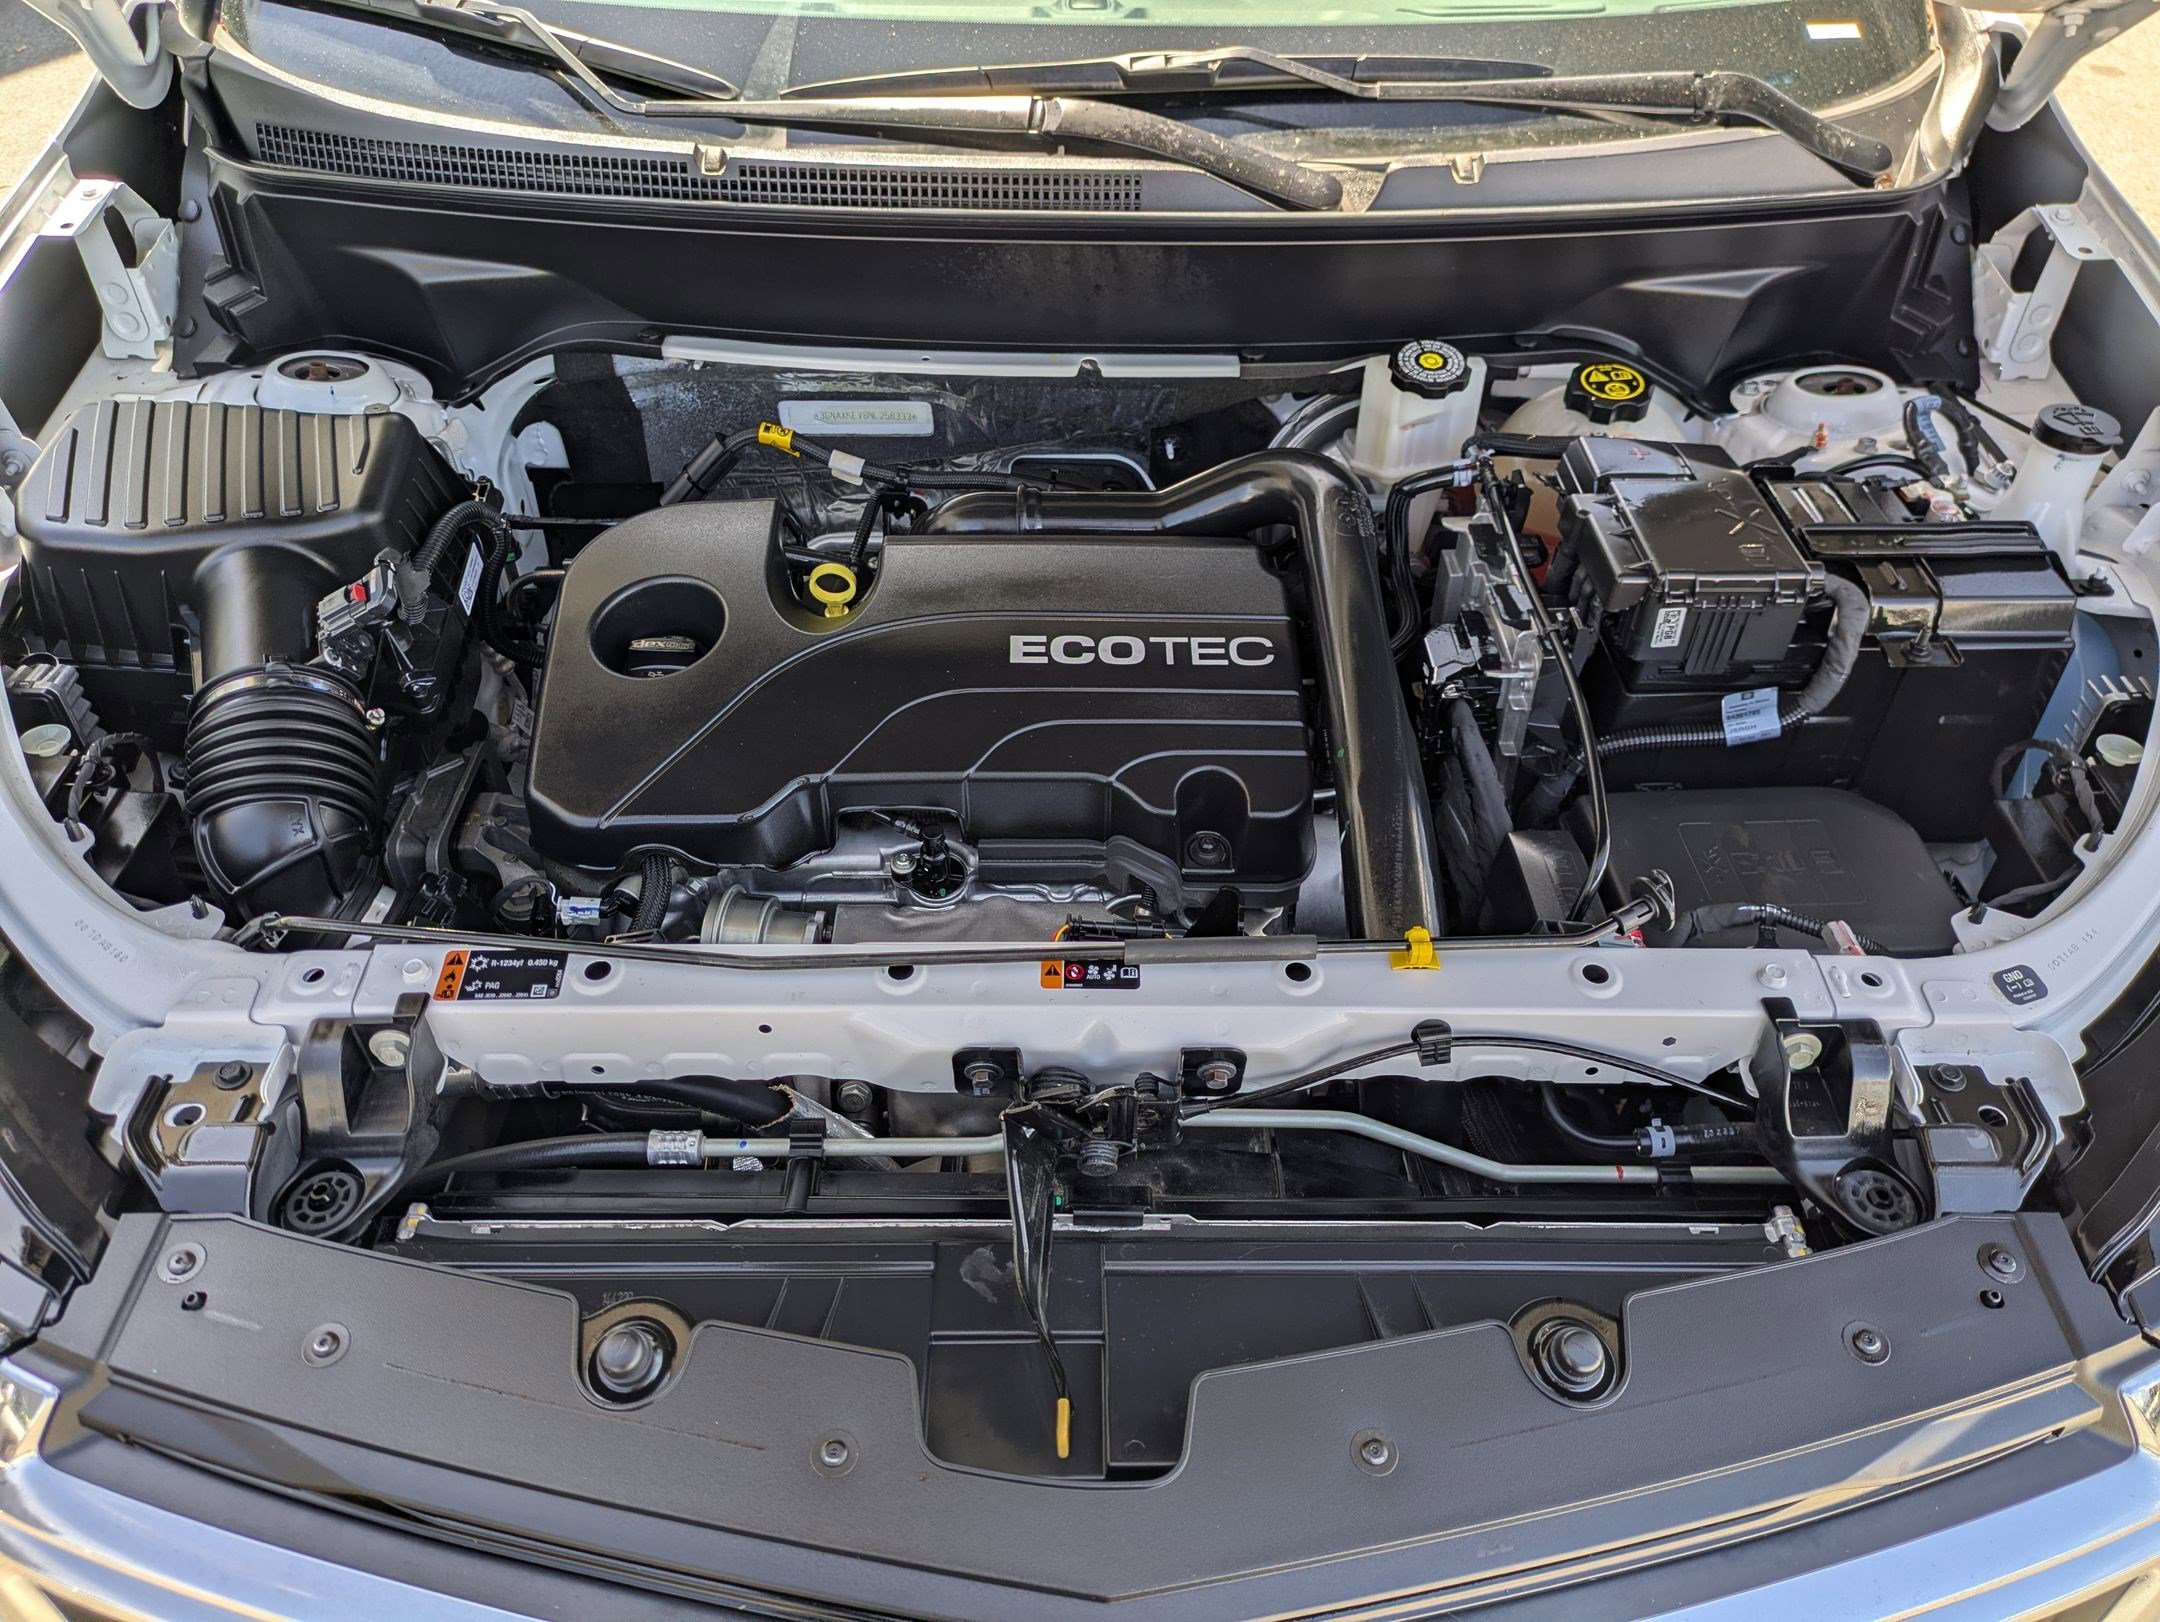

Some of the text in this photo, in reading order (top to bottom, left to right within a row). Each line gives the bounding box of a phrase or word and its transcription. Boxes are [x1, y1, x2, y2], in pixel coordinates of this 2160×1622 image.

[1009, 635, 1275, 666] ECOTEC
[490, 959, 559, 968] R-1234yf 0.450 kg
[2002, 969, 2024, 983] GND
[484, 981, 500, 989] PAG
